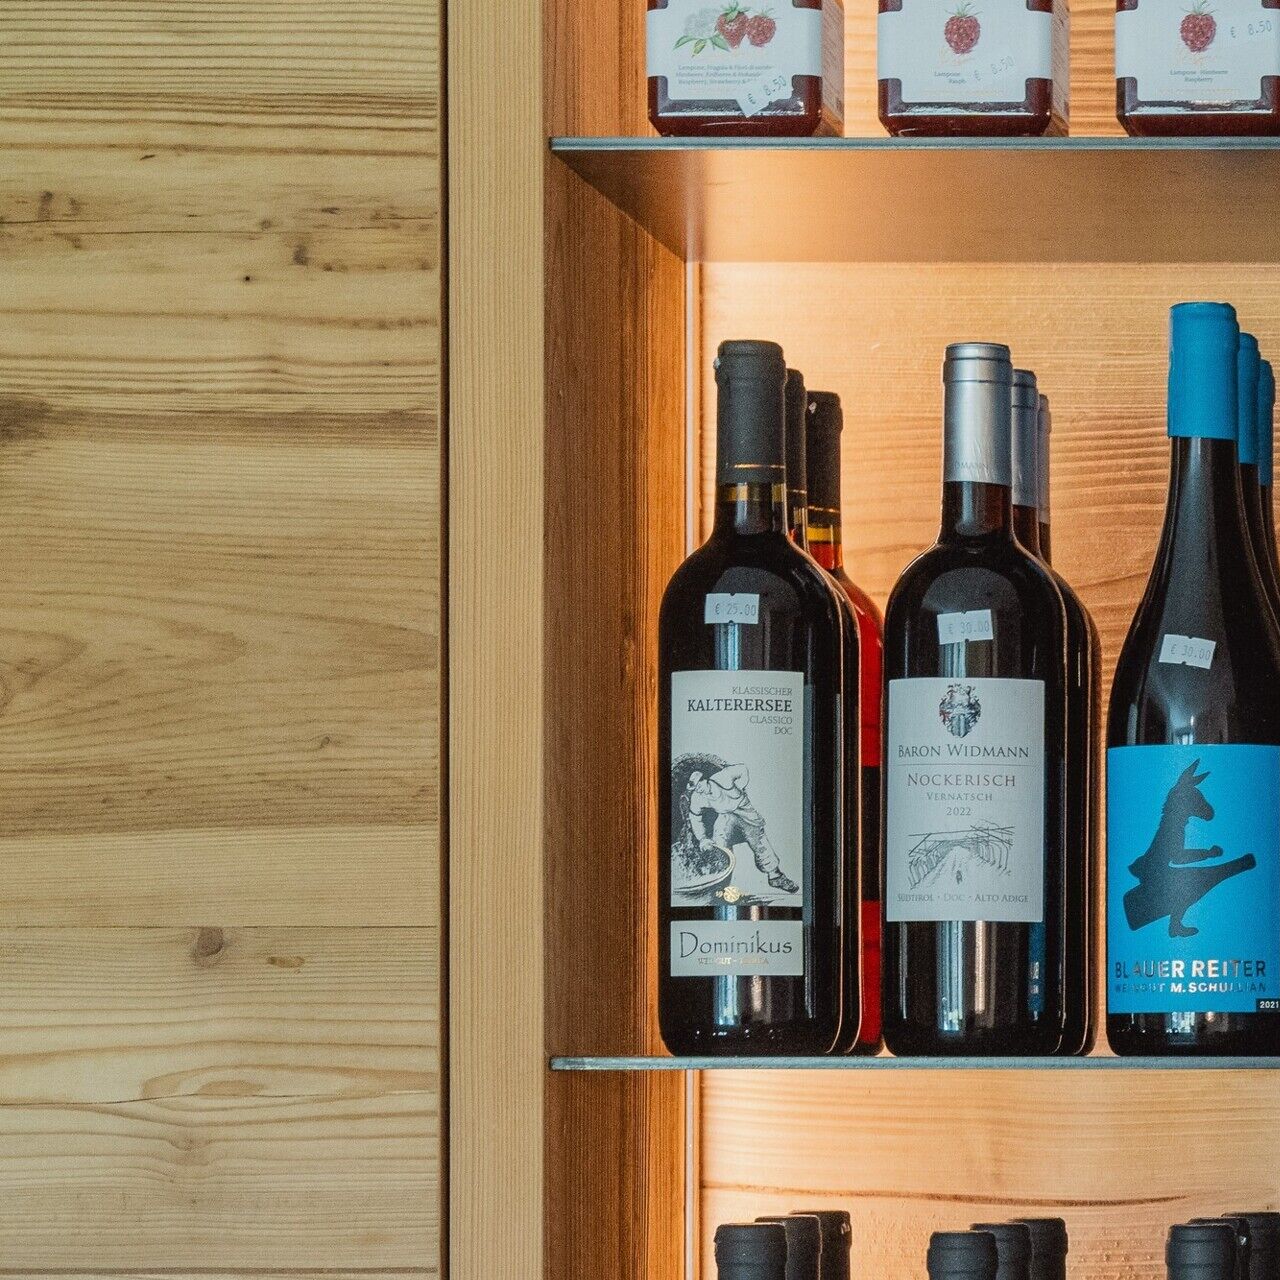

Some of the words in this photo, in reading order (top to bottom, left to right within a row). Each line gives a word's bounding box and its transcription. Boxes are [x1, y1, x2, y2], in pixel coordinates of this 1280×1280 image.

[727, 603, 757, 616] 25.00
[732, 686, 793, 696] KLASSISCHER
[687, 699, 793, 712] KALTERERSEE
[749, 716, 793, 724] CLASSICO
[774, 727, 793, 735] DOC
[898, 745, 941, 758] BARON
[948, 744, 1029, 758] WIDMANN
[908, 773, 1015, 787] NOCKERISCH
[927, 792, 993, 801] VERNATSCH
[946, 807, 972, 816] 2022
[975, 894, 999, 902] ALTO
[1002, 894, 1029, 903] ADIGE
[680, 930, 793, 958] Dominikus
[1115, 960, 1185, 978] BLAUER
[1191, 960, 1266, 978] REITER
[1259, 1001, 1280, 1009] 2021
